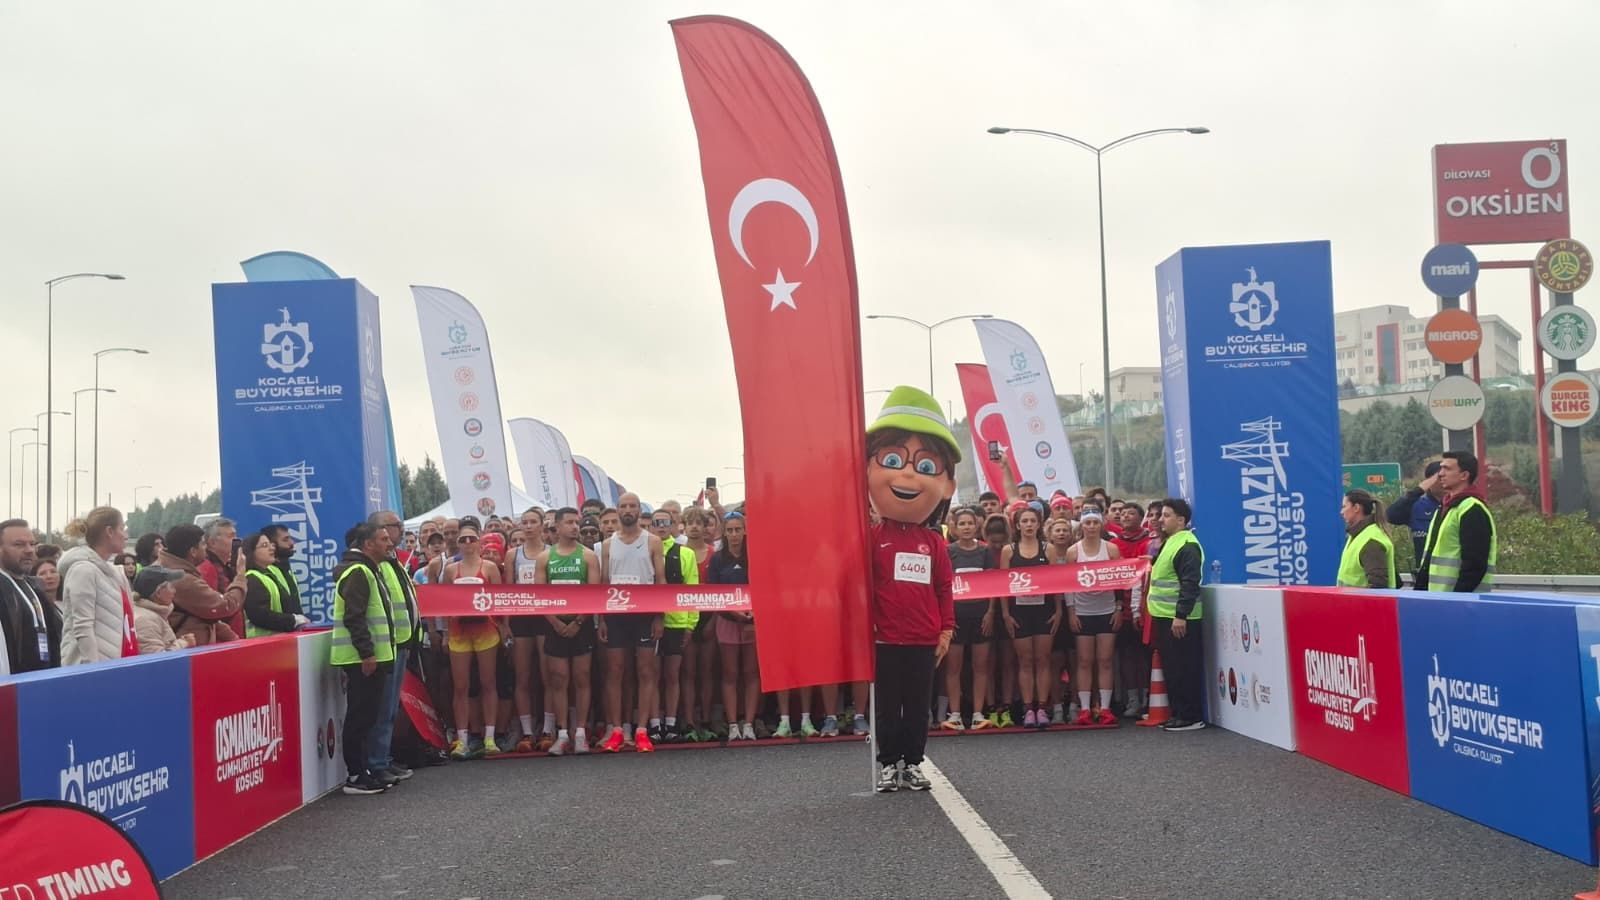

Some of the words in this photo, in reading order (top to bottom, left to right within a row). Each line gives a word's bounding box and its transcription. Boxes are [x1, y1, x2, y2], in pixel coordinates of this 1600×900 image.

[1444, 169, 1491, 180] DİLOVASI
[1446, 189, 1563, 217] OKSİJEN
[1431, 262, 1470, 276] mavi
[1227, 333, 1284, 344] KOCAELİ
[1428, 330, 1478, 342] MIGROS
[258, 376, 318, 387] KOCAELİ
[235, 385, 342, 399] BÜYÜKŞEHİR
[1551, 392, 1589, 400] BURGER
[1431, 398, 1482, 408] SUBWAY
[1551, 400, 1590, 412] KING
[550, 566, 580, 574] ALGERIA
[900, 562, 926, 574] 6406
[1449, 678, 1499, 707] KOCAELİ
[1451, 704, 1543, 749] BÜYÜKŞEHİR
[87, 750, 136, 783] KOCAELİ
[88, 766, 169, 813] BÜYÜKŞEHİR
[37, 859, 131, 900] TIMING
